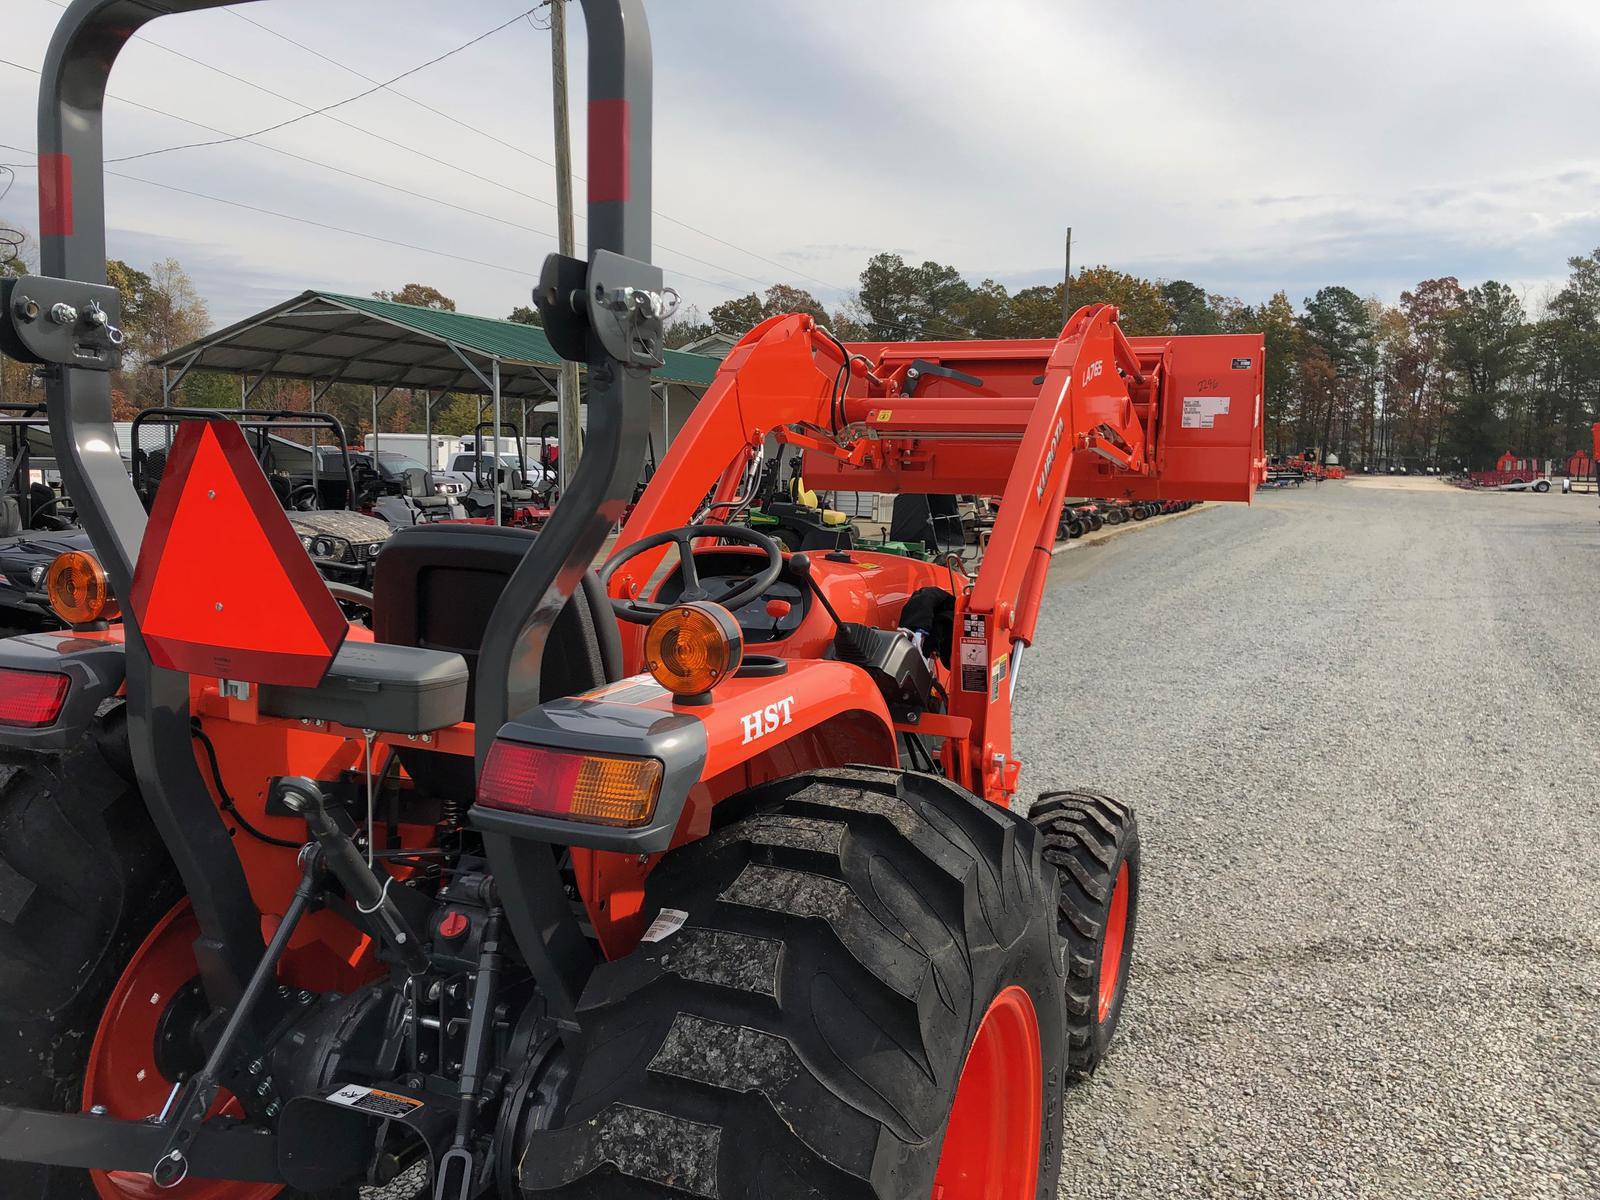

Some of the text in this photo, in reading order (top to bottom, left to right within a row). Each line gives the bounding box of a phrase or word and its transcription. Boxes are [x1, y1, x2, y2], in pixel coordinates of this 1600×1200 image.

[1082, 360, 1103, 387] LA765
[1036, 416, 1064, 504] KUBOTA
[740, 695, 794, 745] HST
